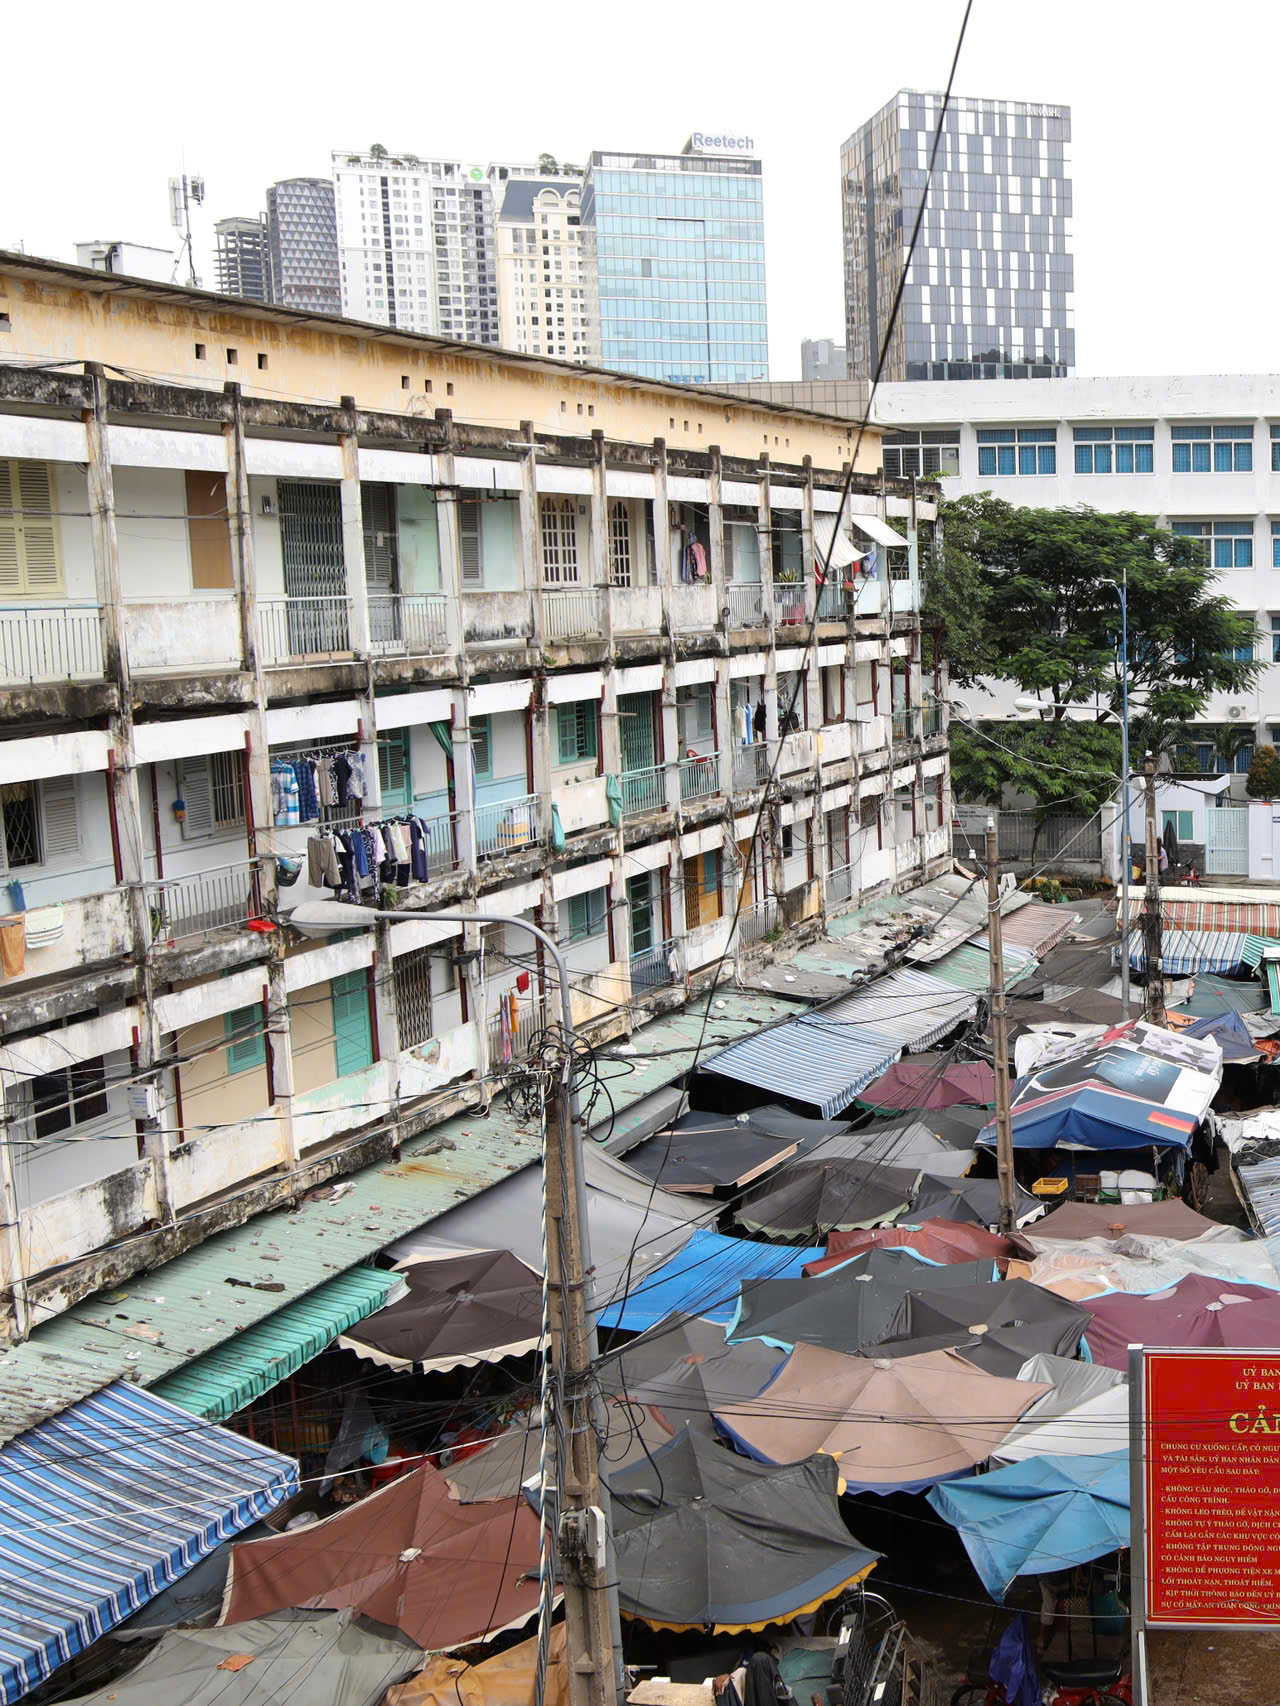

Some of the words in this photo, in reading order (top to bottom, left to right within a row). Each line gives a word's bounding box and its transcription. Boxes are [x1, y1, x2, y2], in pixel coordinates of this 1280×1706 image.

[693, 132, 754, 150] Reetech
[1242, 1365, 1257, 1376] UỶ
[1235, 1378, 1249, 1389] UỶ
[1253, 1381, 1274, 1390] BAN
